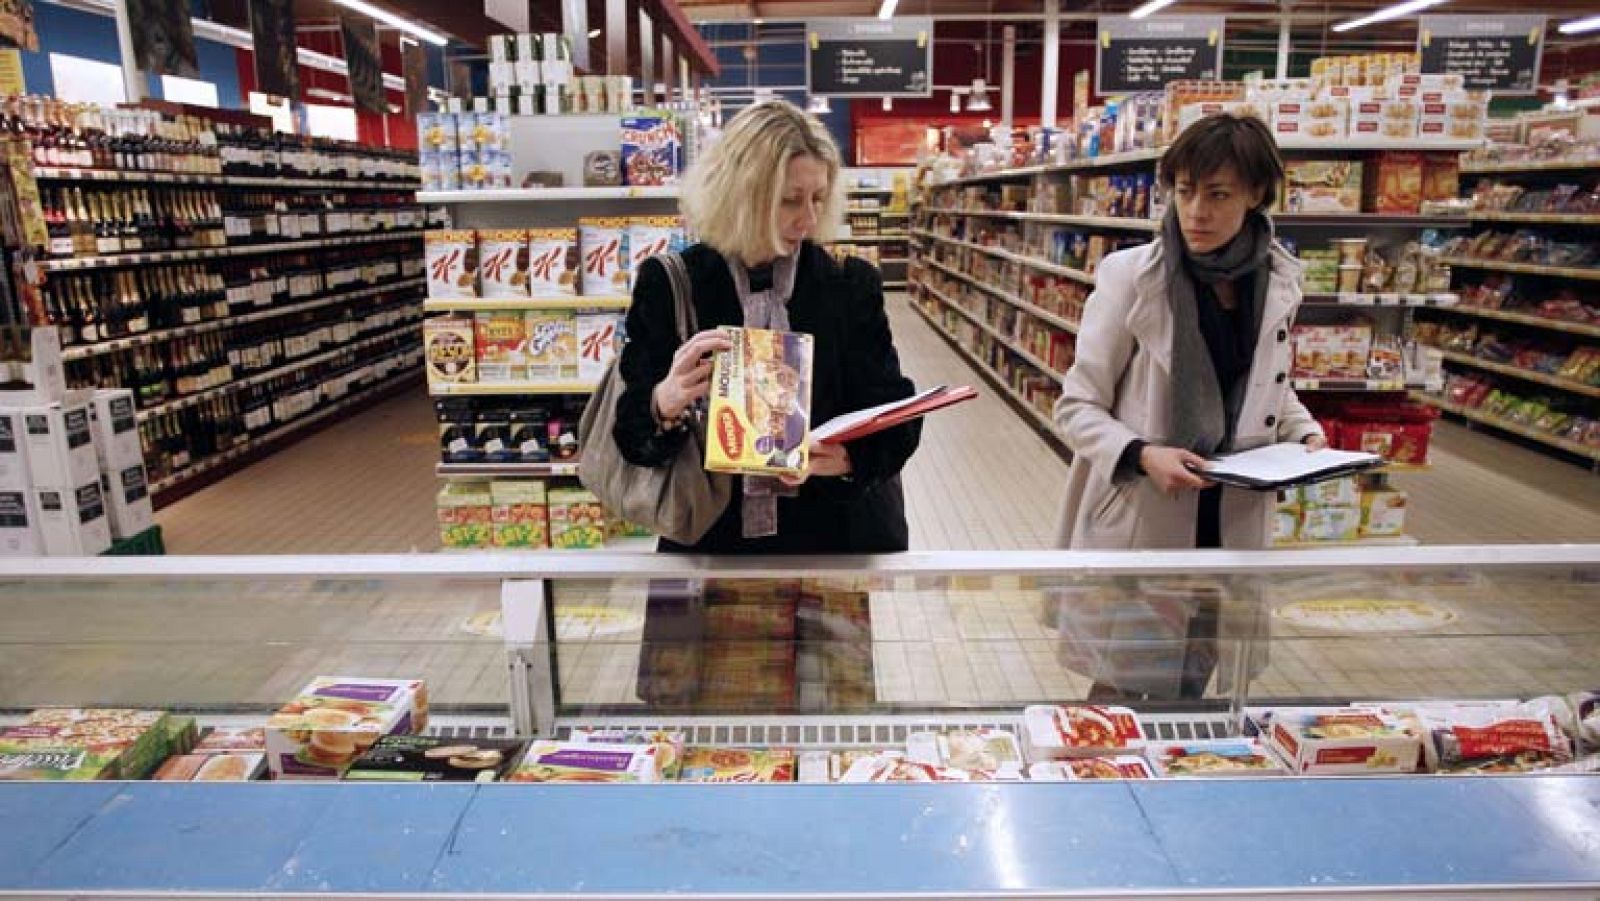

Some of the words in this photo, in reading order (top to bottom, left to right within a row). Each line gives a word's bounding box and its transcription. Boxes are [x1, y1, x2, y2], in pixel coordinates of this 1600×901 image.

[623, 122, 676, 144] CRUNCH
[431, 249, 460, 284] K
[484, 248, 512, 283] K
[533, 247, 561, 281] K
[583, 324, 615, 362] K
